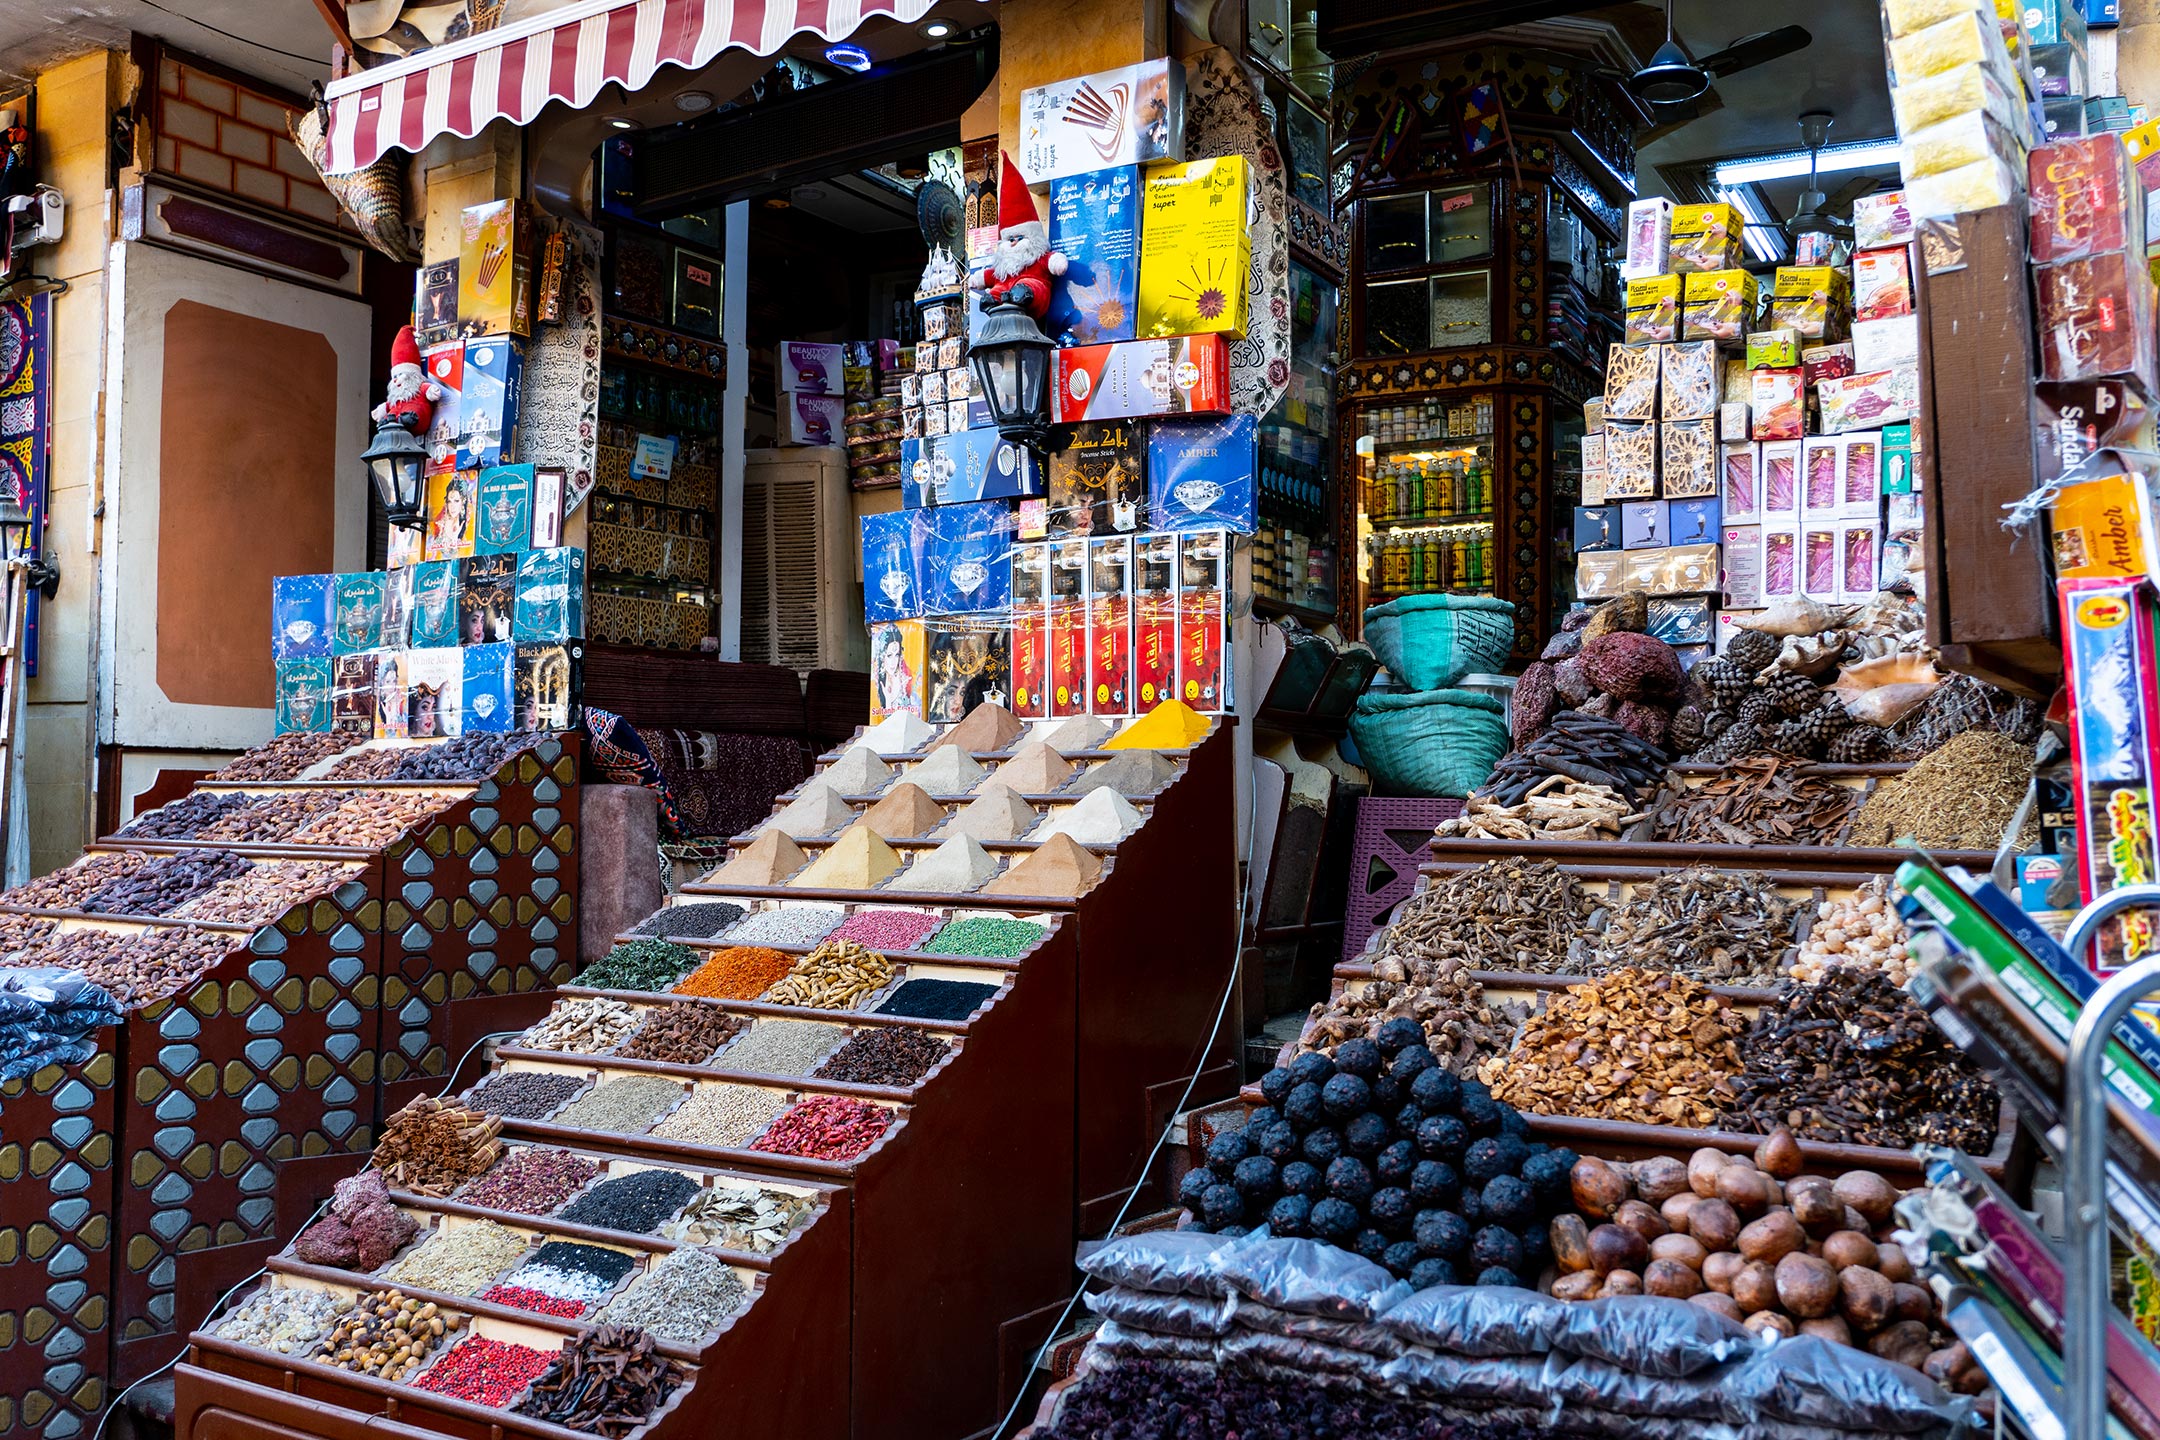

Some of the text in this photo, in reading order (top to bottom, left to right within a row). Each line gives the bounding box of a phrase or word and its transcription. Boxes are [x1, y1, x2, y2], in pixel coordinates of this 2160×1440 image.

[1152, 200, 1176, 212] super
[1056, 211, 1078, 224] super
[791, 346, 822, 354] BEAUTY
[799, 397, 825, 406] BEAUTY
[2060, 405, 2086, 471] Sandal
[1177, 448, 1218, 458] AMBER
[951, 533, 982, 543] AMBER
[2099, 505, 2133, 574] Amber
[938, 622, 968, 633] Black
[519, 647, 539, 658] Black
